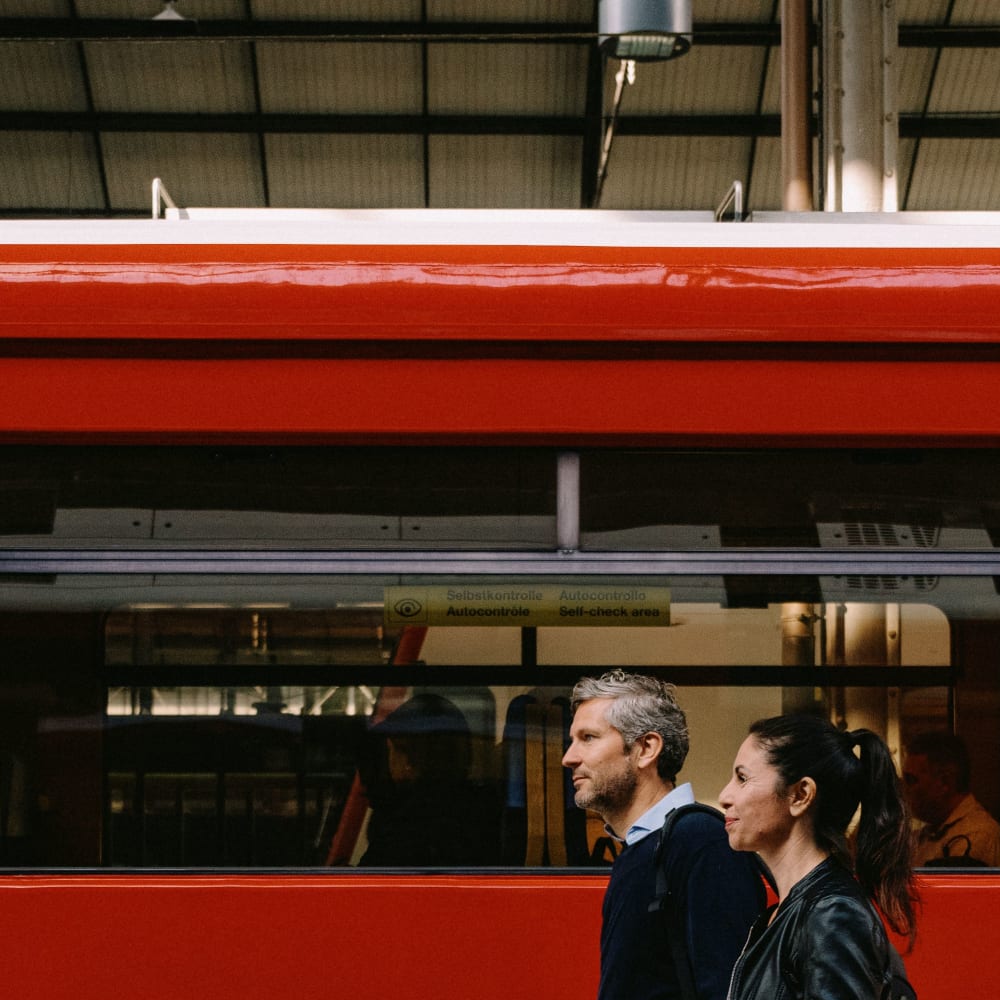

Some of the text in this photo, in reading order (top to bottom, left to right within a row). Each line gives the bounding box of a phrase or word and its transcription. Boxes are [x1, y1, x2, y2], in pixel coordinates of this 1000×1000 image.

[447, 589, 543, 601] Selbstkontrolle
[559, 590, 646, 601] Autocontrollo
[446, 605, 530, 617] Autocontrôle
[559, 605, 660, 617] Self-check area
